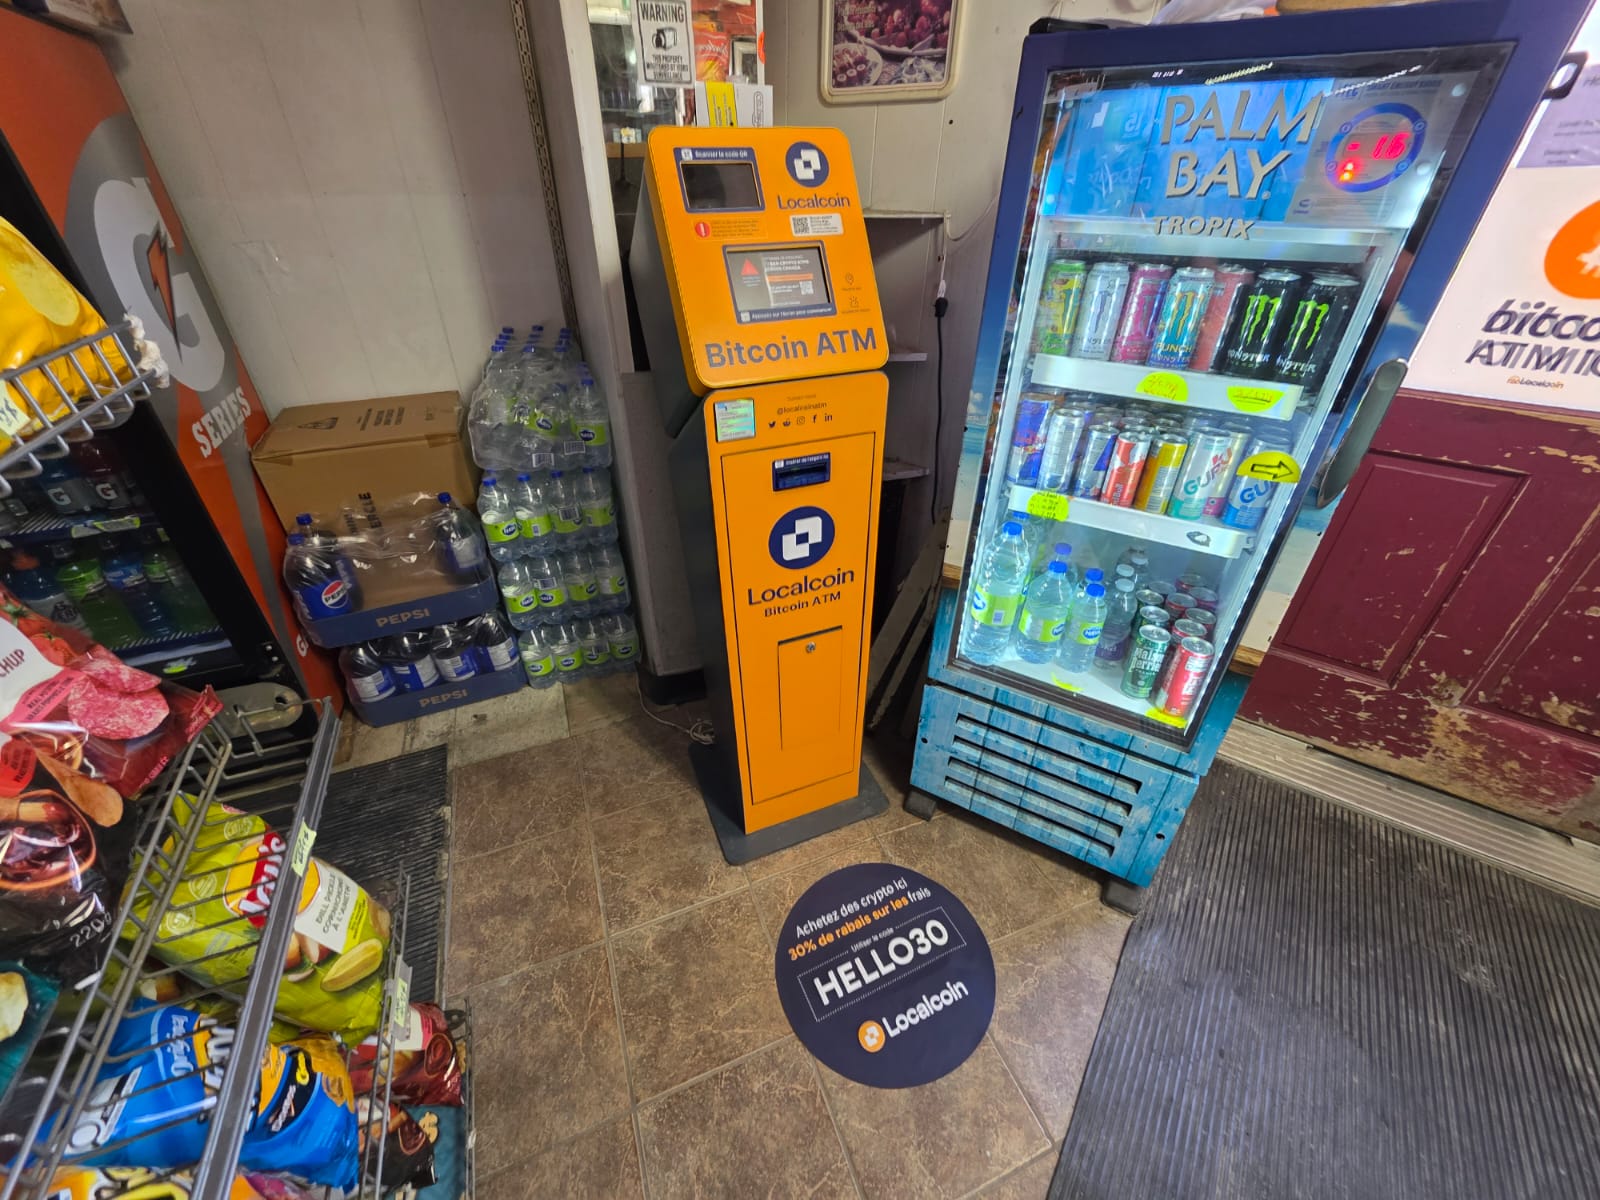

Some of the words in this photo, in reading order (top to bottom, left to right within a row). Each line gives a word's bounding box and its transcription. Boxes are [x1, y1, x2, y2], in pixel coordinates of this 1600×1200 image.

[640, 1, 685, 23] WARNING
[1160, 88, 1327, 145] PALM
[1165, 149, 1292, 200] BAY
[777, 193, 851, 210] Localcoin
[1152, 215, 1254, 241] TROPIX
[704, 335, 809, 369] Bitcoin
[816, 327, 877, 357] ATM
[191, 386, 252, 459] SERIES
[1239, 480, 1274, 504] GU
[376, 607, 431, 629] PEPSI
[419, 688, 468, 708] PEPSI
[315, 901, 330, 925] DILL
[324, 872, 337, 903] PICKLE
[788, 940, 817, 961] 30%
[818, 933, 835, 948] de
[835, 914, 872, 939] rabais
[872, 904, 891, 921] sur
[891, 896, 910, 911] les
[907, 887, 932, 904] frais
[796, 908, 840, 939] Achetez
[840, 900, 860, 918] des
[860, 885, 895, 910] crypto
[895, 876, 908, 891] ici
[813, 919, 949, 1007] HELLO30
[882, 980, 970, 1039] Localcoin
